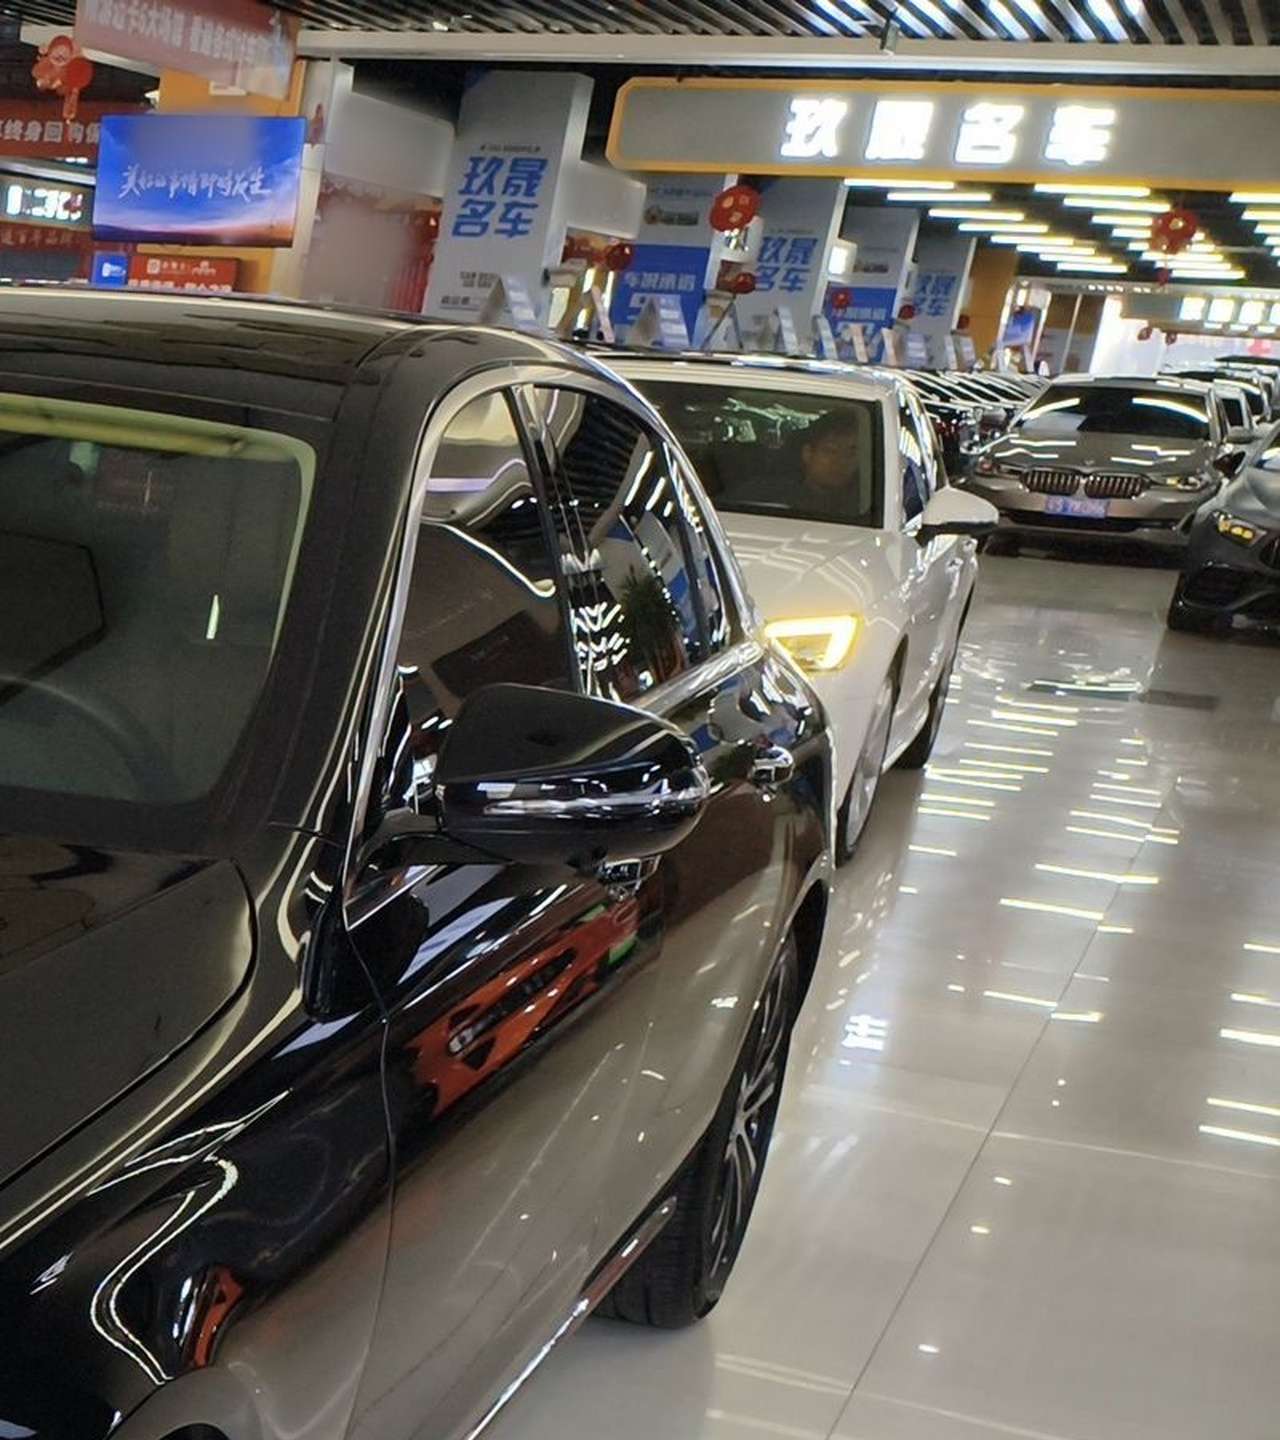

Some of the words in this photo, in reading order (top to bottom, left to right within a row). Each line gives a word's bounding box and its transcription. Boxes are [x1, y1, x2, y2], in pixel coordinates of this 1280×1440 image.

[780, 98, 1117, 166] 玖晟名车
[458, 156, 549, 197] 玖晟
[451, 198, 539, 238] 名车
[755, 236, 819, 265] 玖晟
[755, 266, 811, 293] 名车
